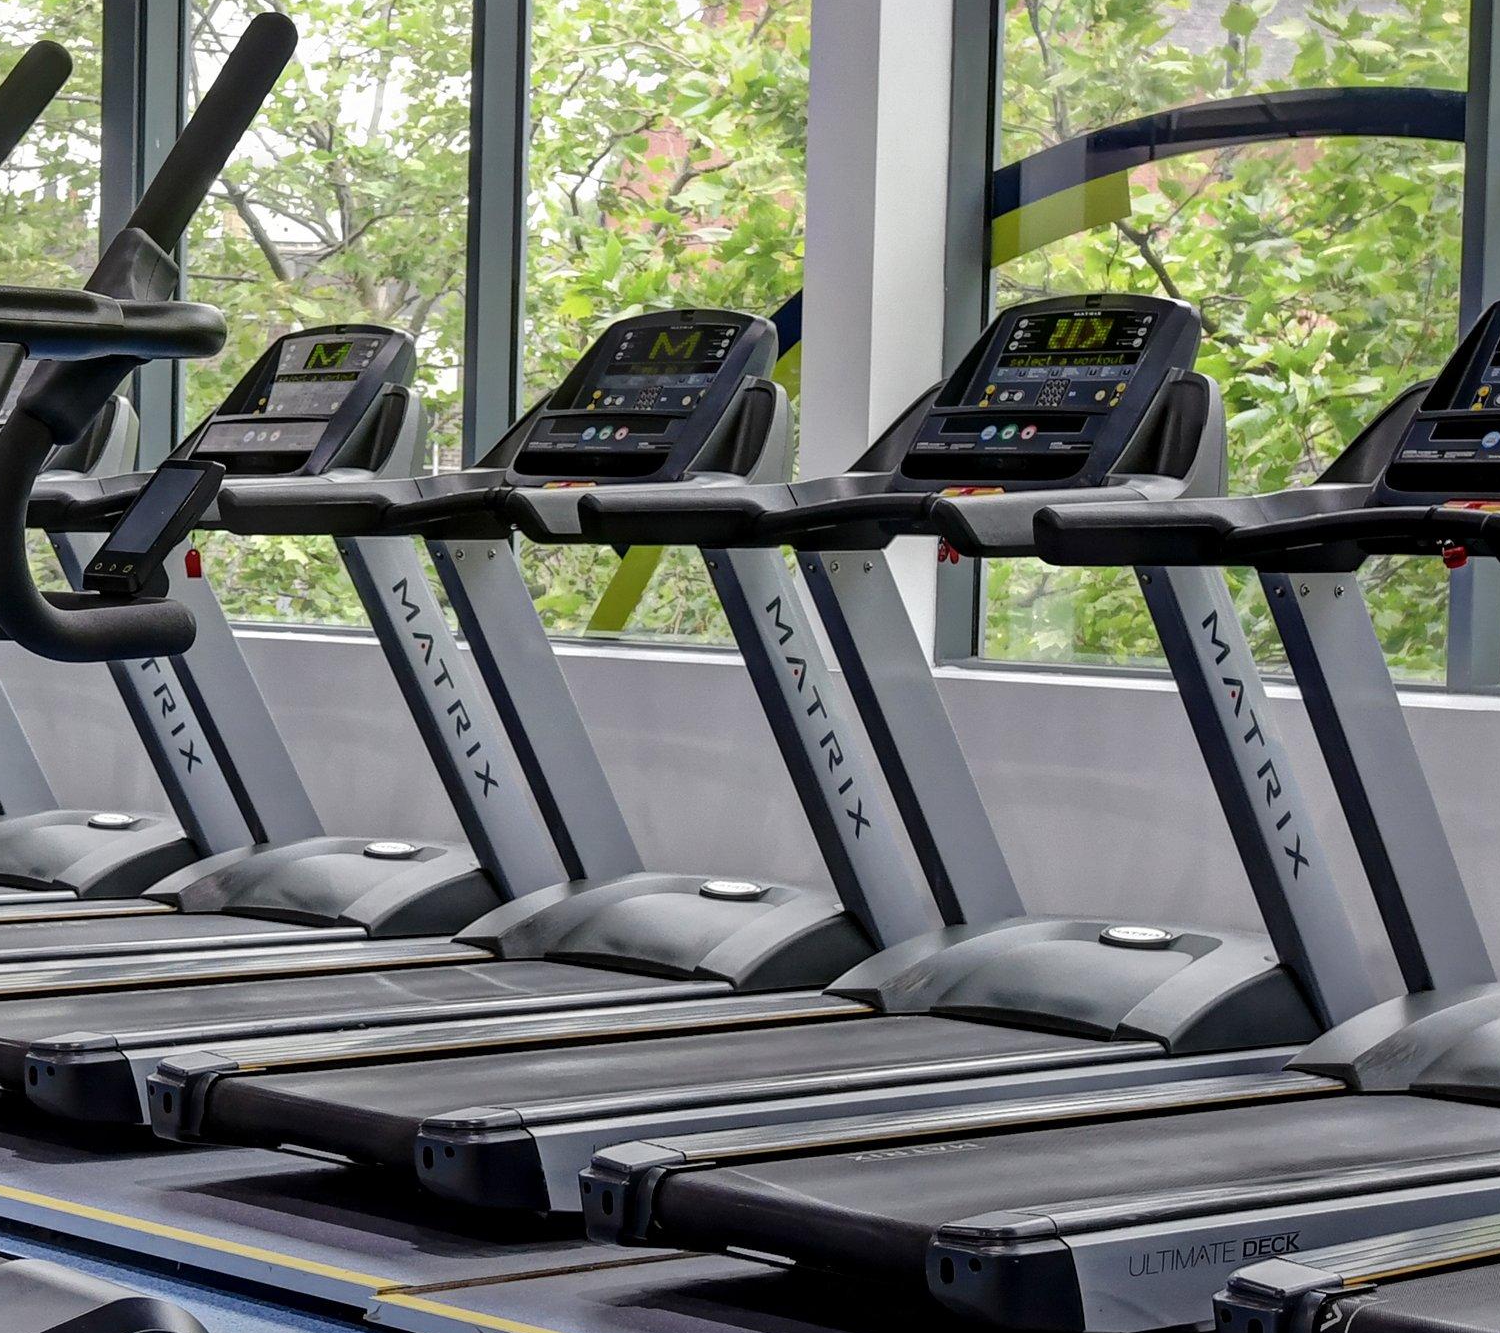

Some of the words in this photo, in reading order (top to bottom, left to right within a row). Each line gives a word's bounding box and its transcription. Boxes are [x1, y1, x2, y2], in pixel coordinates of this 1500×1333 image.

[391, 577, 500, 799] MATRIX
[765, 596, 871, 840] MATRIX
[1202, 609, 1310, 881] MATRIX
[1128, 1239, 1237, 1278] ULTIMATE
[1242, 1231, 1301, 1260] DECK
